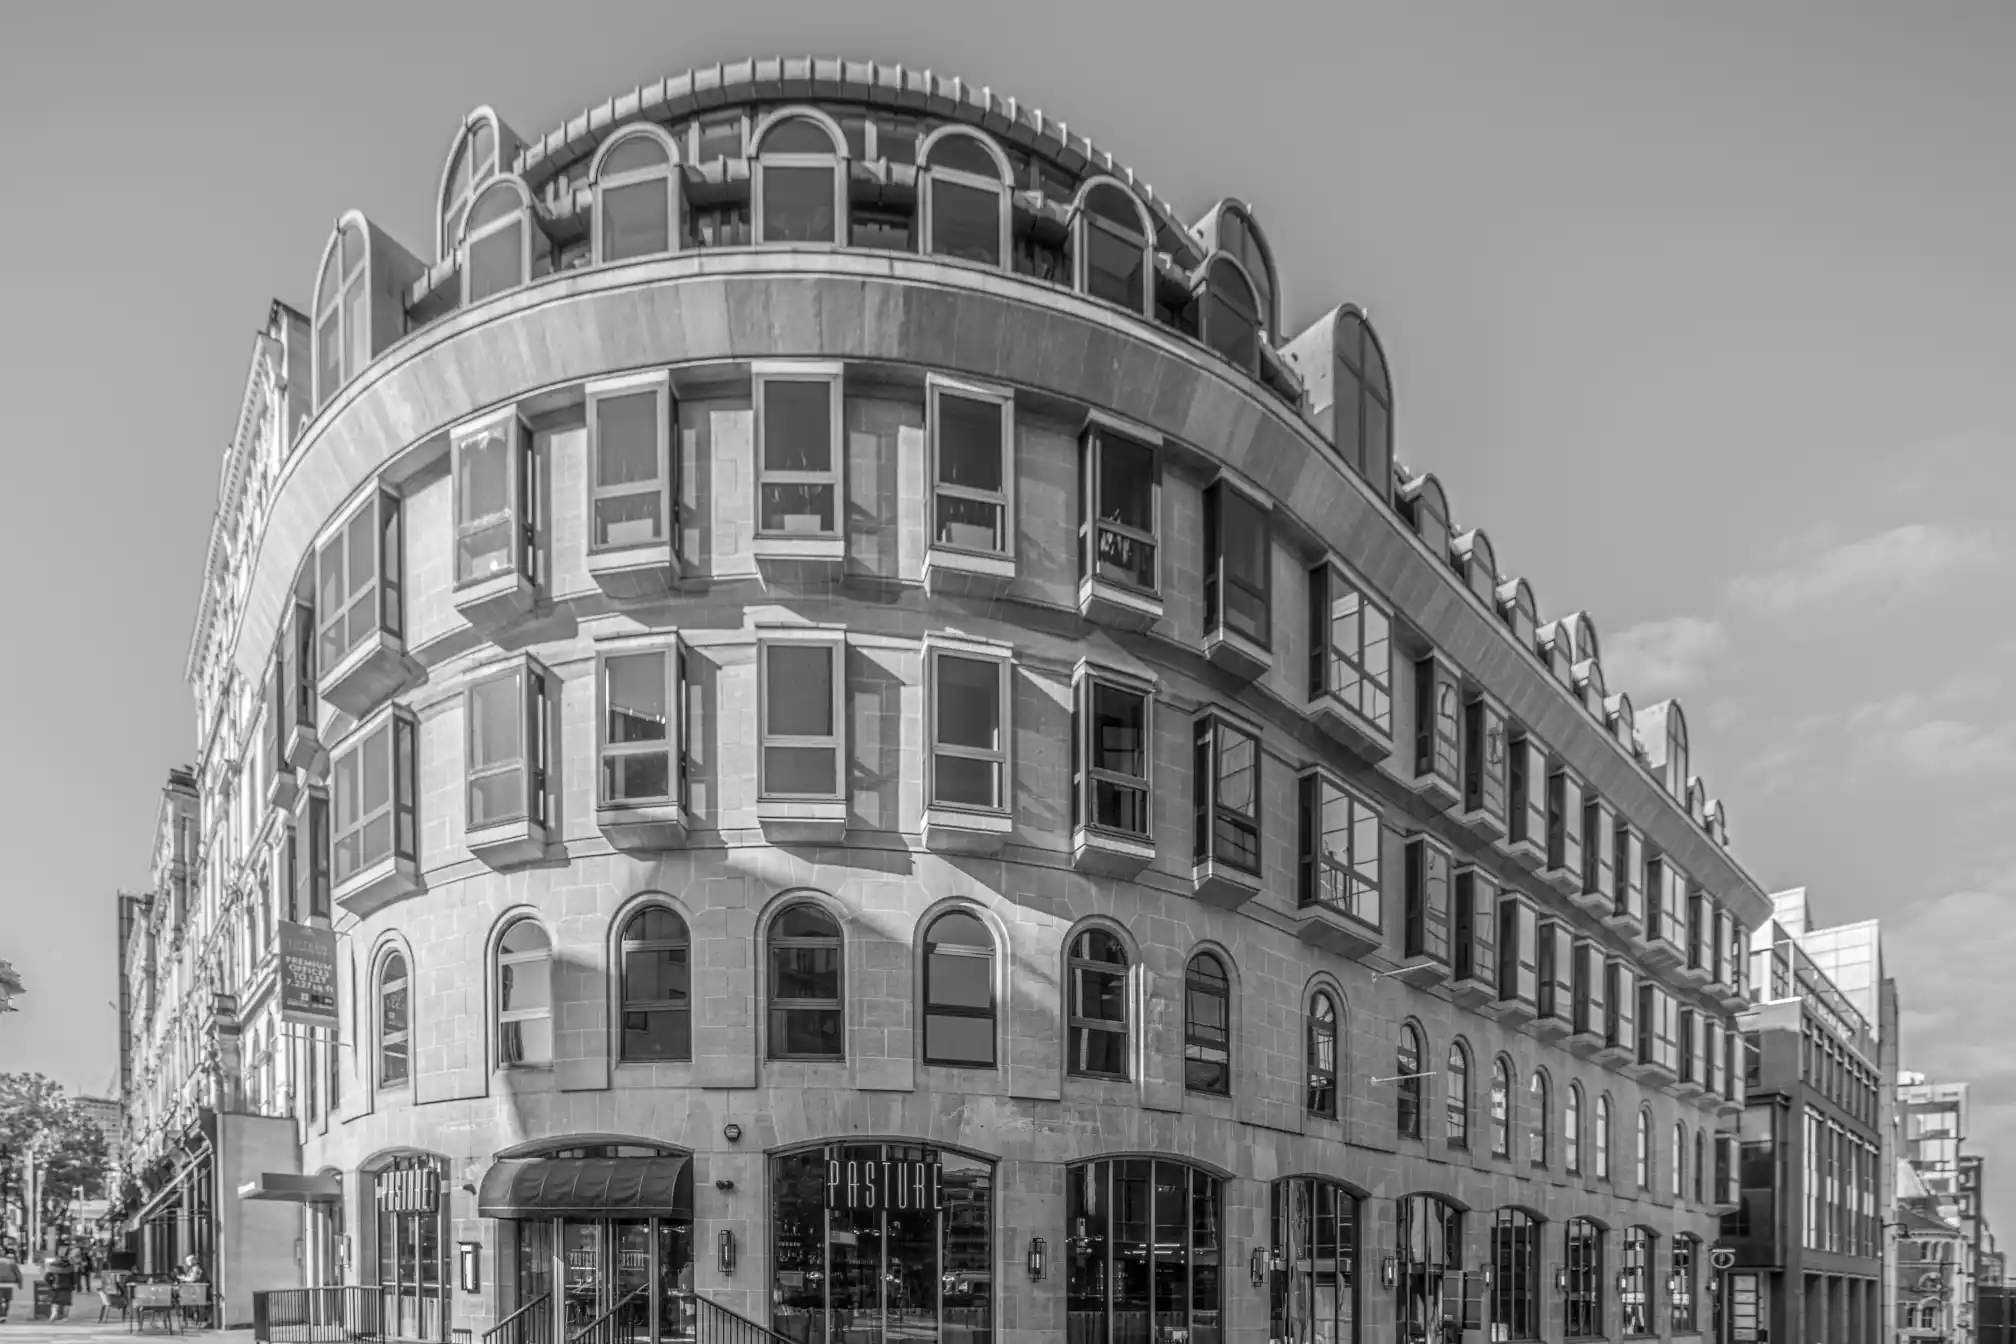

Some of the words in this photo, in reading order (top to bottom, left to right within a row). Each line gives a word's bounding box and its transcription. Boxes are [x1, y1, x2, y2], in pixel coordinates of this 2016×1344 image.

[285, 955, 333, 970] PREMIUM
[288, 963, 330, 978] OFFICES
[292, 971, 307, 981] TO
[309, 975, 327, 985] LET
[381, 1168, 429, 1212] PASTURE
[827, 1160, 943, 1210] PASTURE
